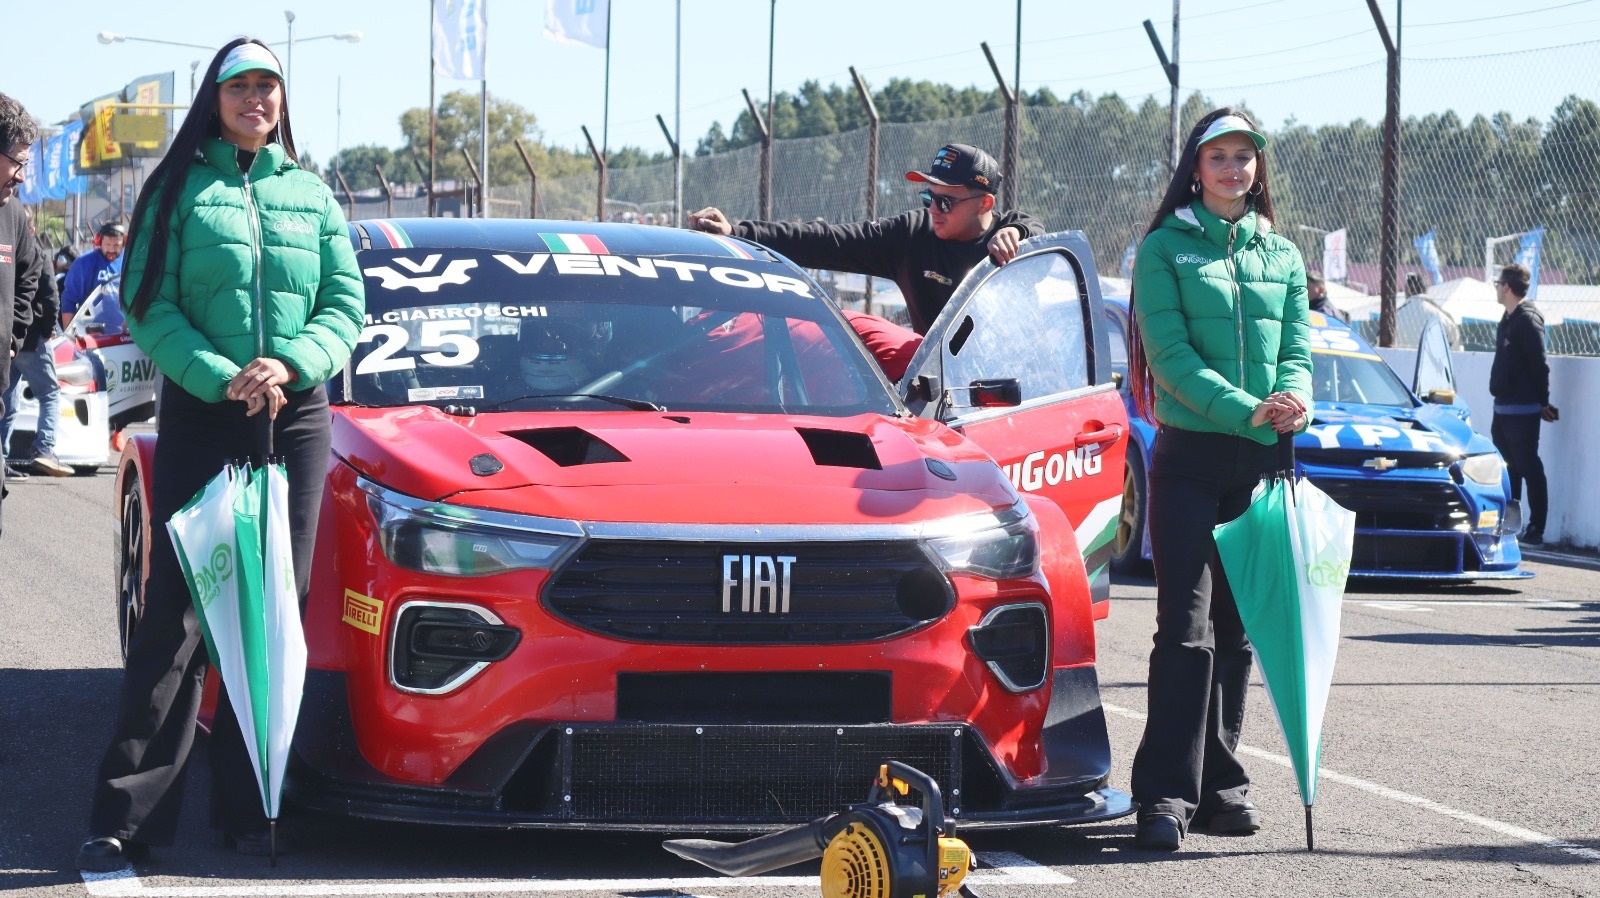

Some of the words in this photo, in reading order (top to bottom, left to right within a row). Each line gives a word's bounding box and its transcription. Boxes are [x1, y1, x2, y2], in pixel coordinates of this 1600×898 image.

[492, 254, 816, 299] VENTOR
[355, 318, 480, 375] 25
[1306, 424, 1446, 451] YPF
[722, 554, 797, 614] FIAT
[345, 595, 378, 627] PIRELLI
